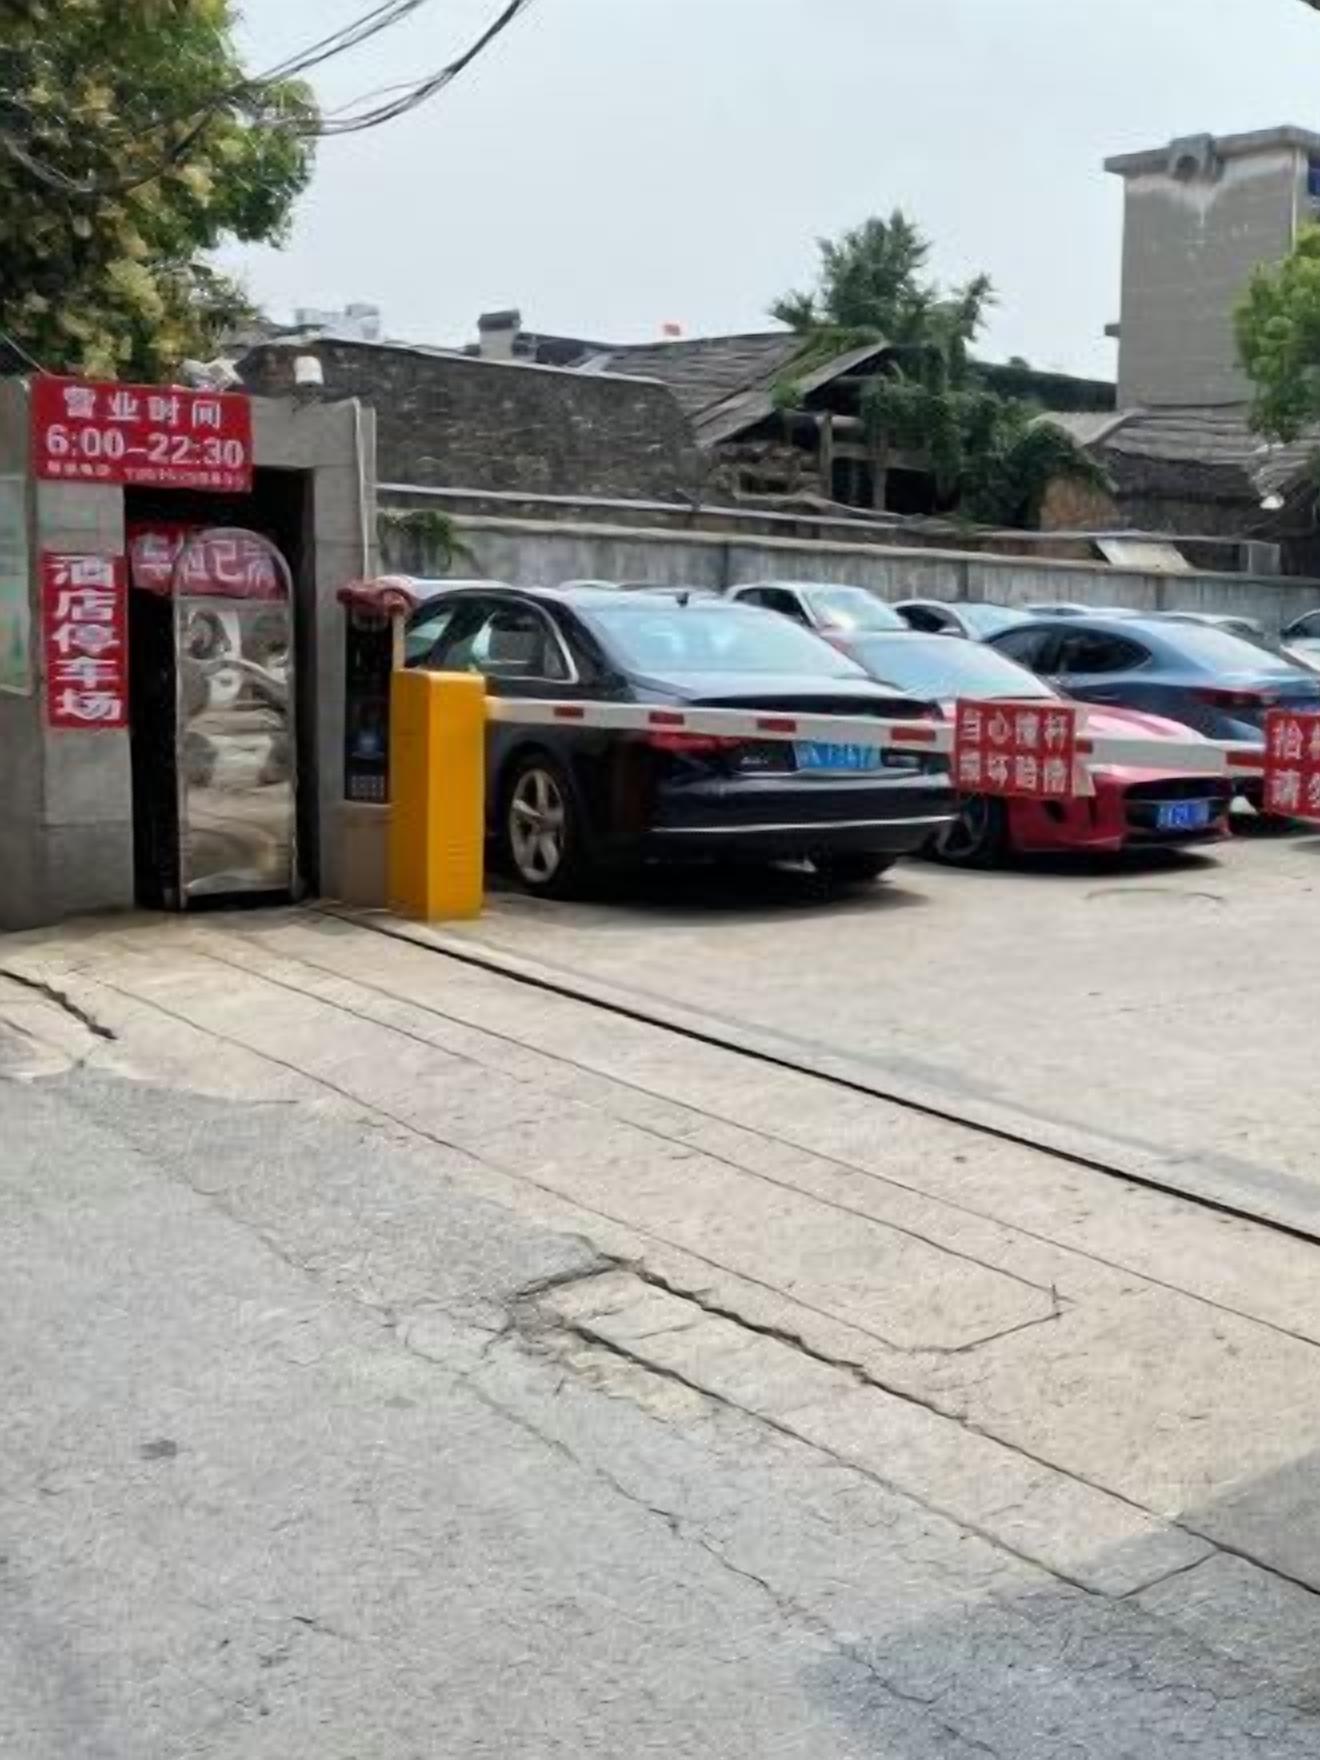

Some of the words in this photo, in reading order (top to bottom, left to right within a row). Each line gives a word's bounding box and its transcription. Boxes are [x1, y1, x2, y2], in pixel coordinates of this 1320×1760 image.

[63, 386, 221, 430] 营业时间
[46, 424, 244, 468] 6:00-22:30
[52, 555, 122, 720] 酒店停车场
